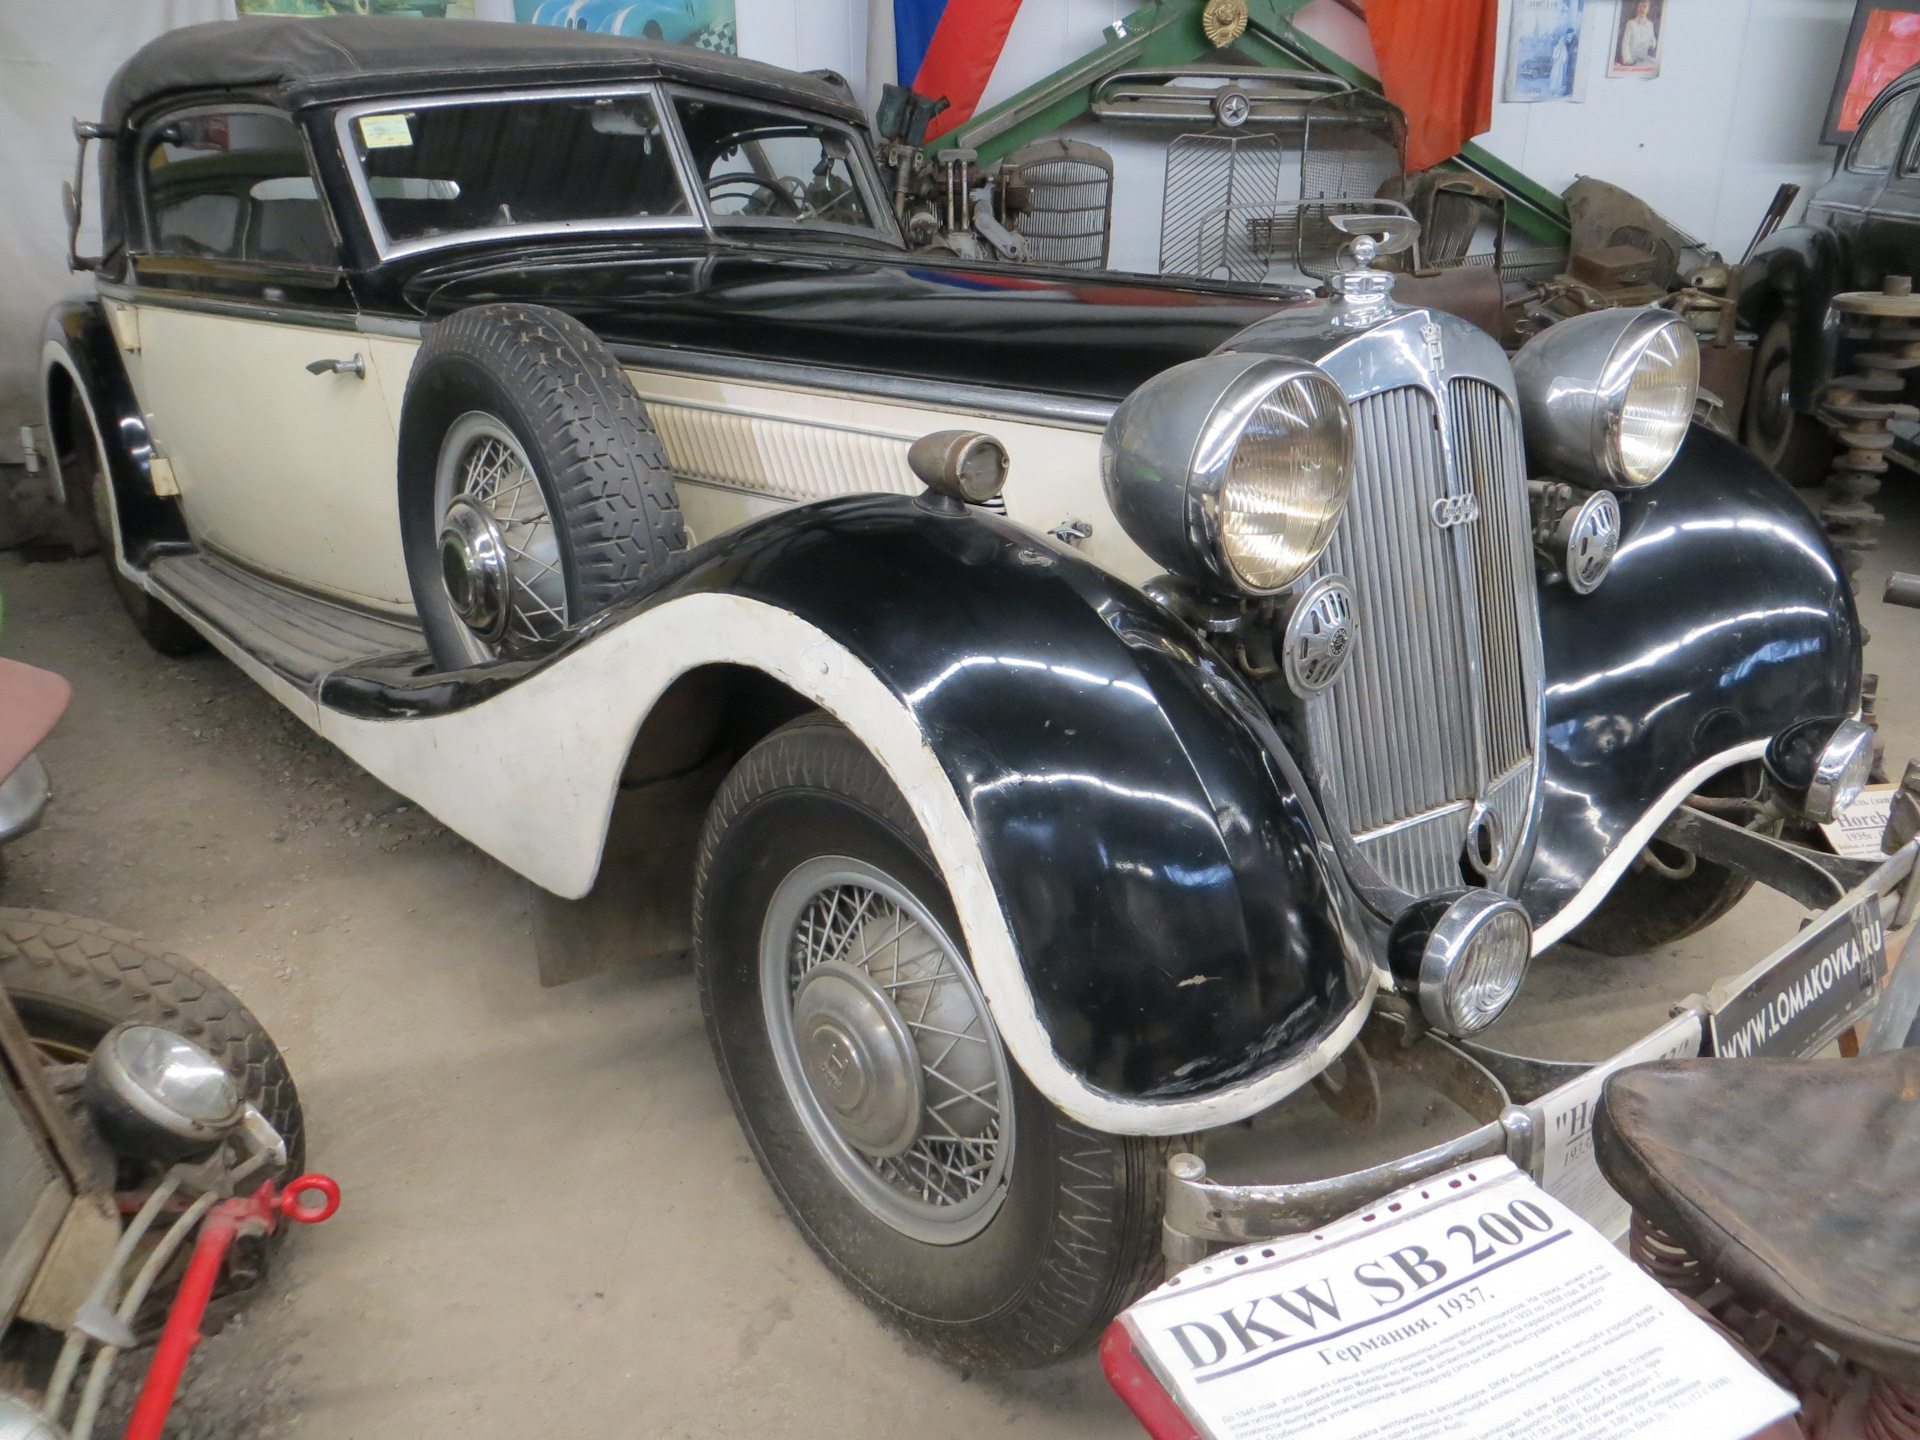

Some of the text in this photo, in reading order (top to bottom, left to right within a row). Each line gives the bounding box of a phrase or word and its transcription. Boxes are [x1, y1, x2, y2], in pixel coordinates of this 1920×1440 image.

[1837, 811, 1888, 828] Horch
[1721, 920, 1882, 1058] WWW.LOMAKOVKA.RU
[1168, 1277, 1342, 1370] DKW
[1354, 1243, 1447, 1307] SB
[1446, 1199, 1554, 1265] 200
[1280, 1394, 1296, 1404] это
[1296, 1386, 1319, 1397] один
[1331, 1372, 1359, 1385] самых
[1438, 1324, 1477, 1345] немецких
[1563, 1272, 1586, 1287] может
[1318, 1286, 1496, 1366] Германия. 1937.
[1228, 1420, 1250, 1431] этом
[1250, 1402, 1304, 1423] гитлеровцы
[1304, 1387, 1341, 1407] доехали
[1353, 1373, 1388, 1387] Москвы
[1400, 1358, 1427, 1372] время
[1457, 1321, 1508, 1347] Выпускался
[1513, 1308, 1533, 1320] 1933
[1283, 1403, 1329, 1425] выпущено
[1330, 1393, 1356, 1406] около
[1412, 1366, 1435, 1377] Рама
[1496, 1326, 1523, 1340] Вилка
[1522, 1286, 1604, 1328] параллелограммного
[1328, 1406, 1350, 1419] этом
[1451, 1361, 1470, 1373] (это
[1481, 1342, 1512, 1359] сильно
[1511, 1322, 1554, 1345] выступает
[1561, 1303, 1593, 1322] сторону
[1350, 1427, 1378, 1440] скала
[1378, 1410, 1428, 1431] мотоциклы
[1487, 1375, 1509, 1389] DKW
[1509, 1365, 1533, 1379] была
[1533, 1353, 1560, 1368] одним
[1387, 1427, 1410, 1440] одно
[1410, 1417, 1442, 1431] кольцо
[1489, 1386, 1516, 1401] колец
[1514, 1369, 1550, 1389] которые
[1550, 1355, 1579, 1371] сейчас
[1578, 1343, 1601, 1358] носят
[1602, 1326, 1636, 1346] машины
[1549, 1392, 1569, 1404] Ход
[1581, 1392, 1618, 1414] Коробка
[1506, 1414, 1552, 1438] Мощность
